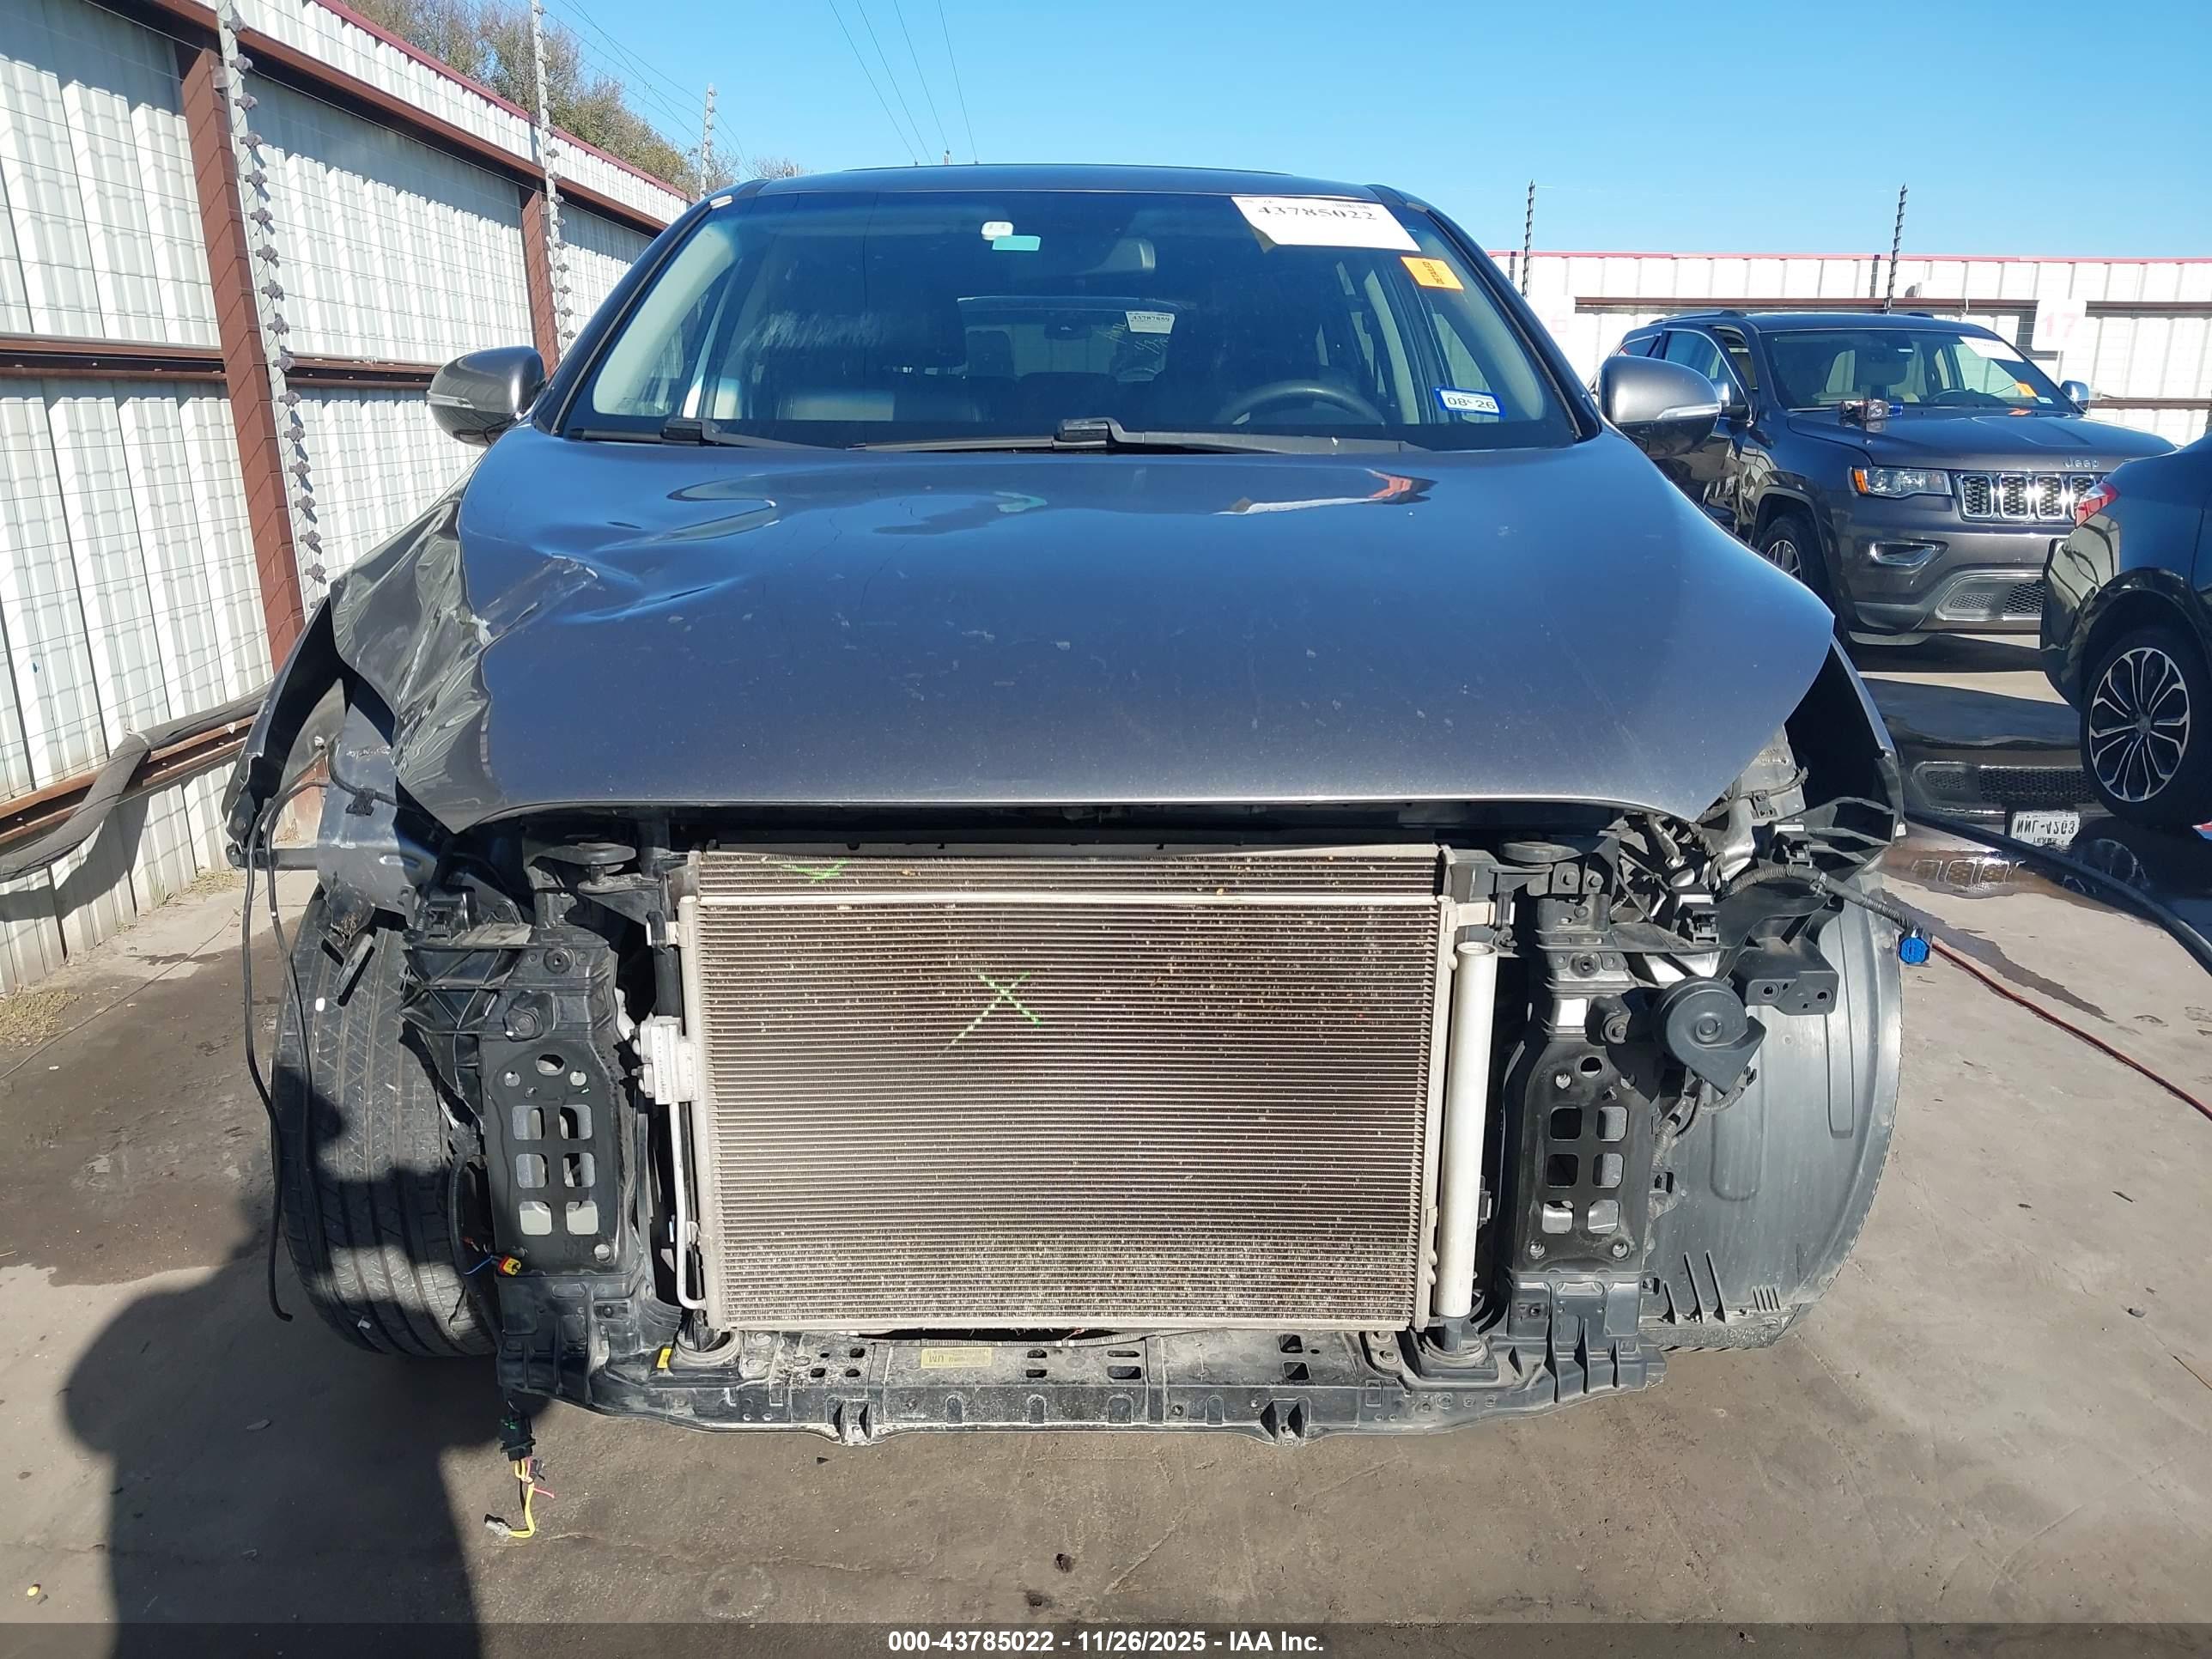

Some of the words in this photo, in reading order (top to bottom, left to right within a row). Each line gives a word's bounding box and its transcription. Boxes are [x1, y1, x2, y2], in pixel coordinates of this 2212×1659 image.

[1258, 206, 1376, 221] 43785022
[2043, 313, 2080, 338] 17
[1447, 397, 1468, 406] 08
[1475, 399, 1496, 410] 26
[2062, 455, 2100, 470] Jeep
